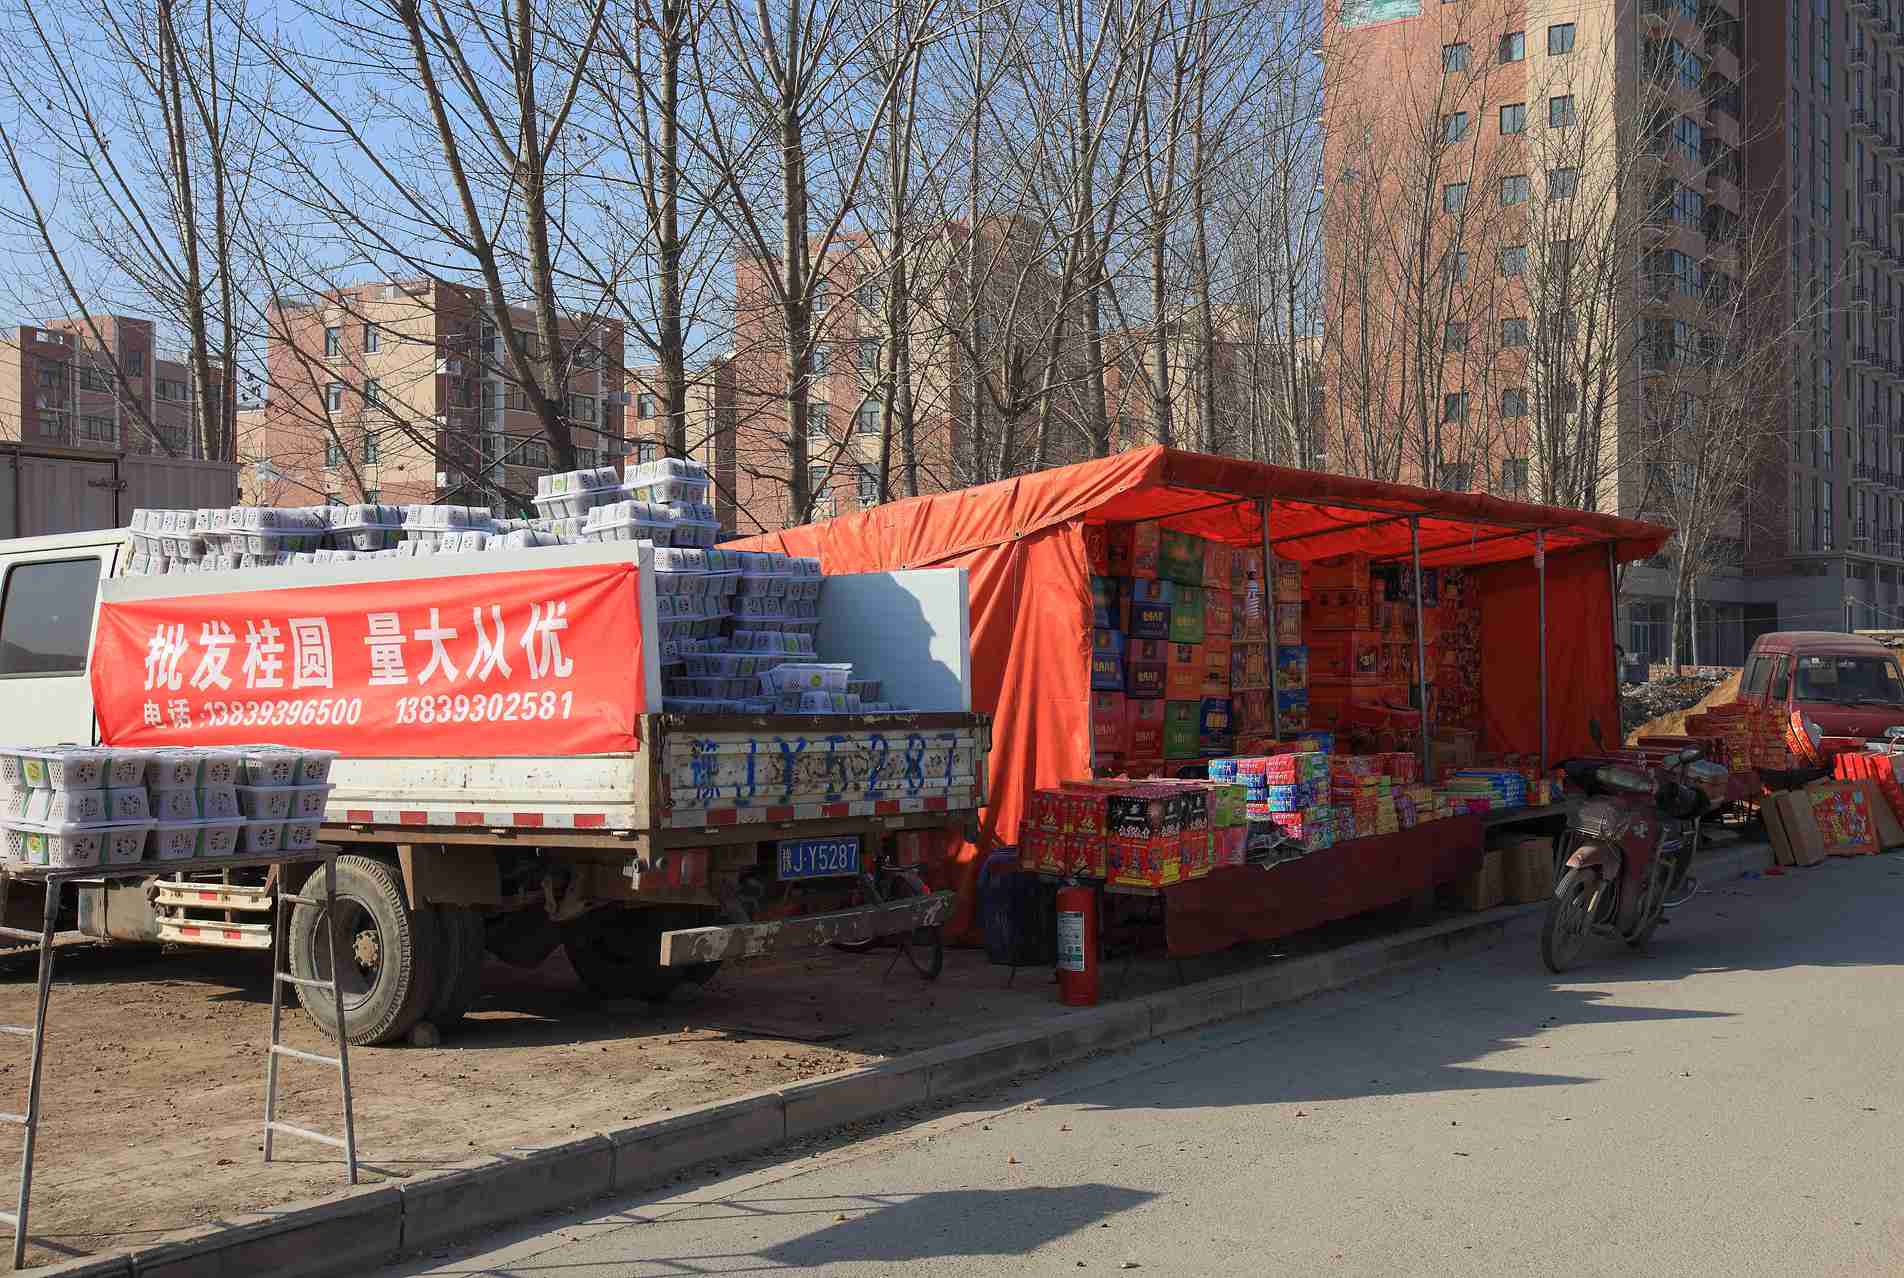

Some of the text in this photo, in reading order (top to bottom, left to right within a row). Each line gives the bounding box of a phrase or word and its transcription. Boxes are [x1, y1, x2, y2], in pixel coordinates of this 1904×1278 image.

[144, 601, 574, 691] 批发桂圆 量大从优
[395, 691, 573, 725] 13839302581
